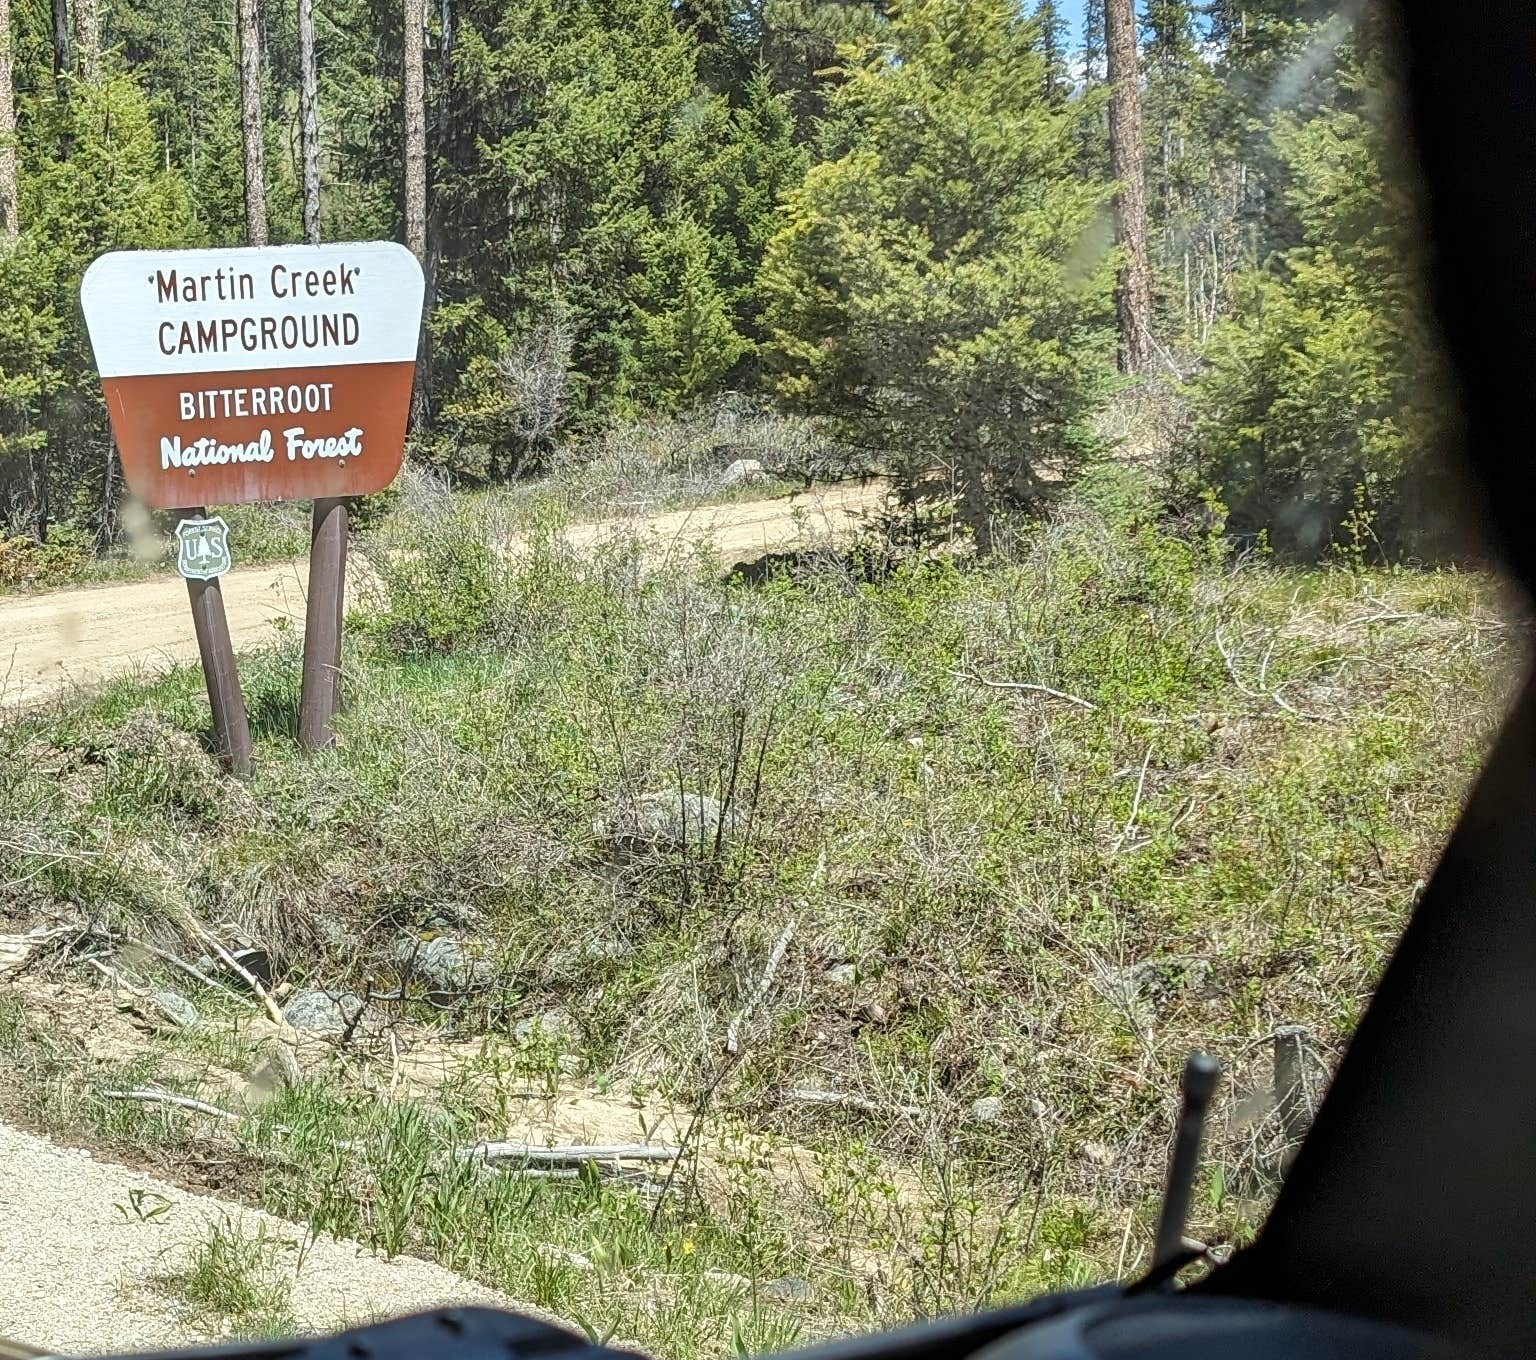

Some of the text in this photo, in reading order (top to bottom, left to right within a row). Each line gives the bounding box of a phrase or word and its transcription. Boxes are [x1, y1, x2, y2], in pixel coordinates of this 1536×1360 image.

[156, 262, 355, 303] Martin Creek
[158, 313, 360, 356] CAMPGROUND
[179, 383, 334, 420] BITTERROOT
[160, 426, 364, 470] National Forest
